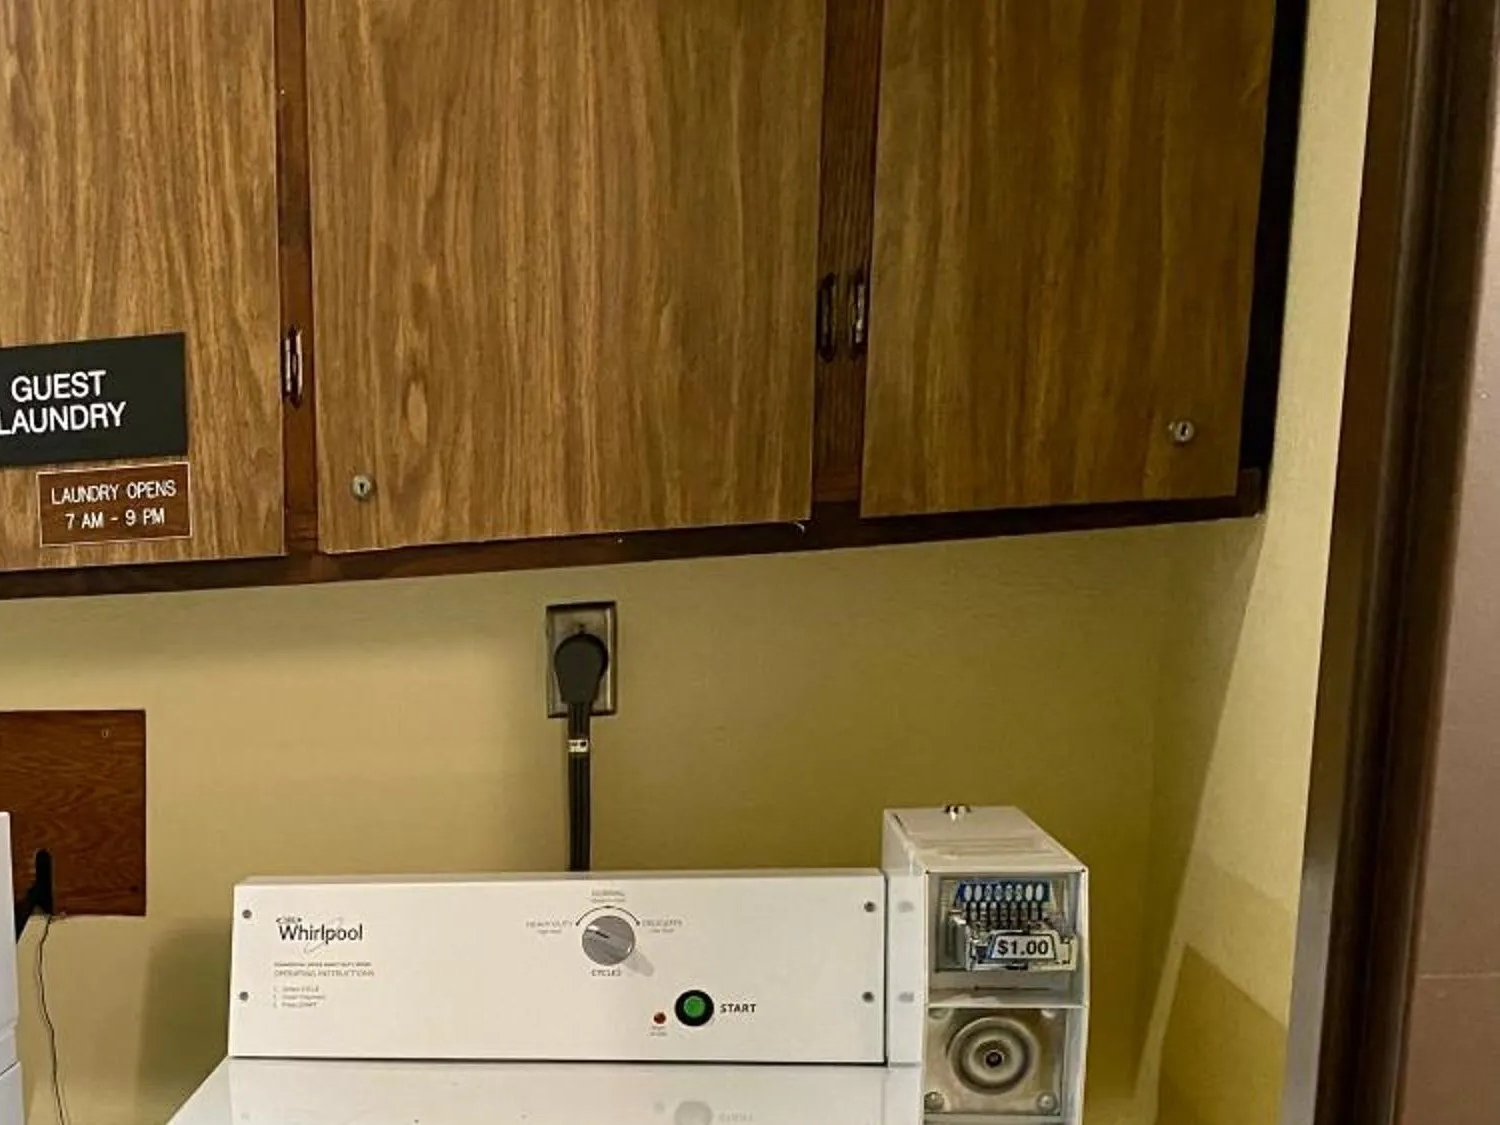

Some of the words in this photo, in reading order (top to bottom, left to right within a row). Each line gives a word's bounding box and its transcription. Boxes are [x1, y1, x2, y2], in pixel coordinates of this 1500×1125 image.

[11, 370, 106, 402] GUEST
[51, 484, 119, 505] LAUNDRY
[126, 479, 177, 499] OPENS
[64, 513, 75, 530] 7
[81, 512, 104, 529] AM
[125, 510, 136, 526] 9
[143, 508, 165, 525] PM
[278, 923, 363, 945] Whirlpool
[997, 939, 1049, 955] $1.00
[720, 1003, 757, 1013] START
